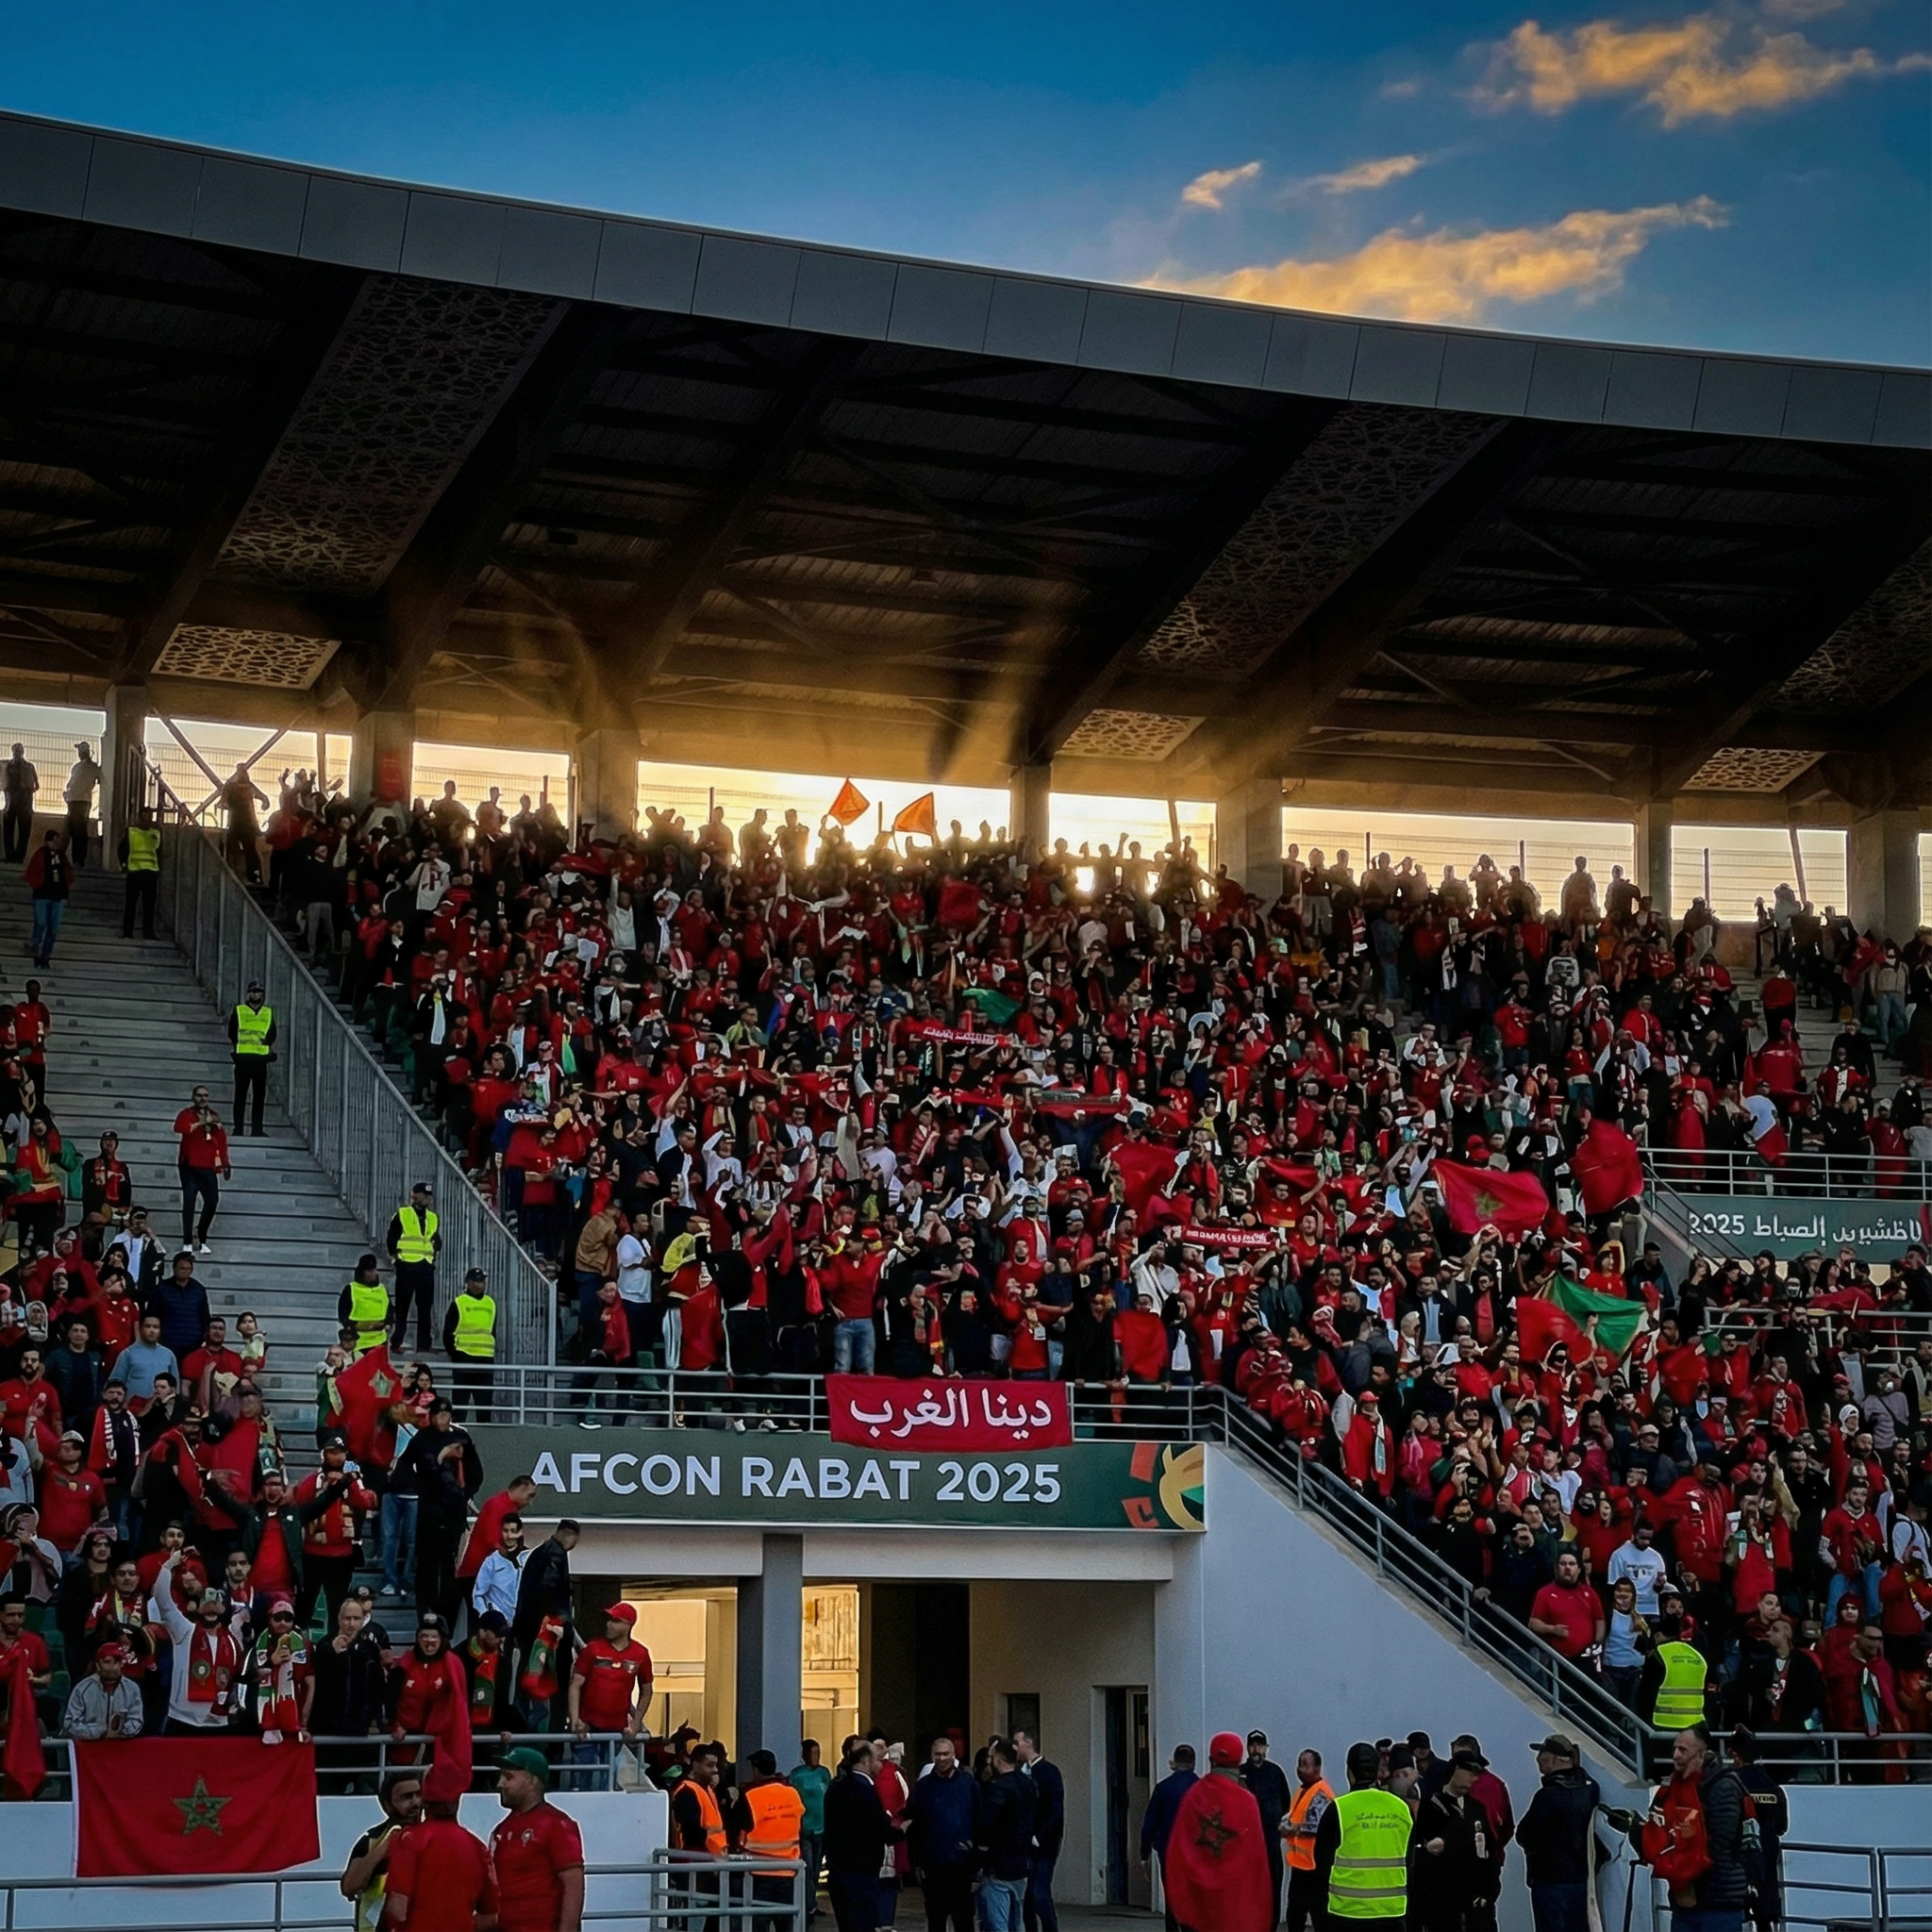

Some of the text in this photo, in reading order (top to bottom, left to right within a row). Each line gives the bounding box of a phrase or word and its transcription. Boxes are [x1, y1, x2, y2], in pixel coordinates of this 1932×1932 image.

[1689, 1212, 1745, 1235] 2025
[850, 1387, 1052, 1440] دينا الغرب
[530, 1452, 1060, 1503] AFCON RABAT 2025
